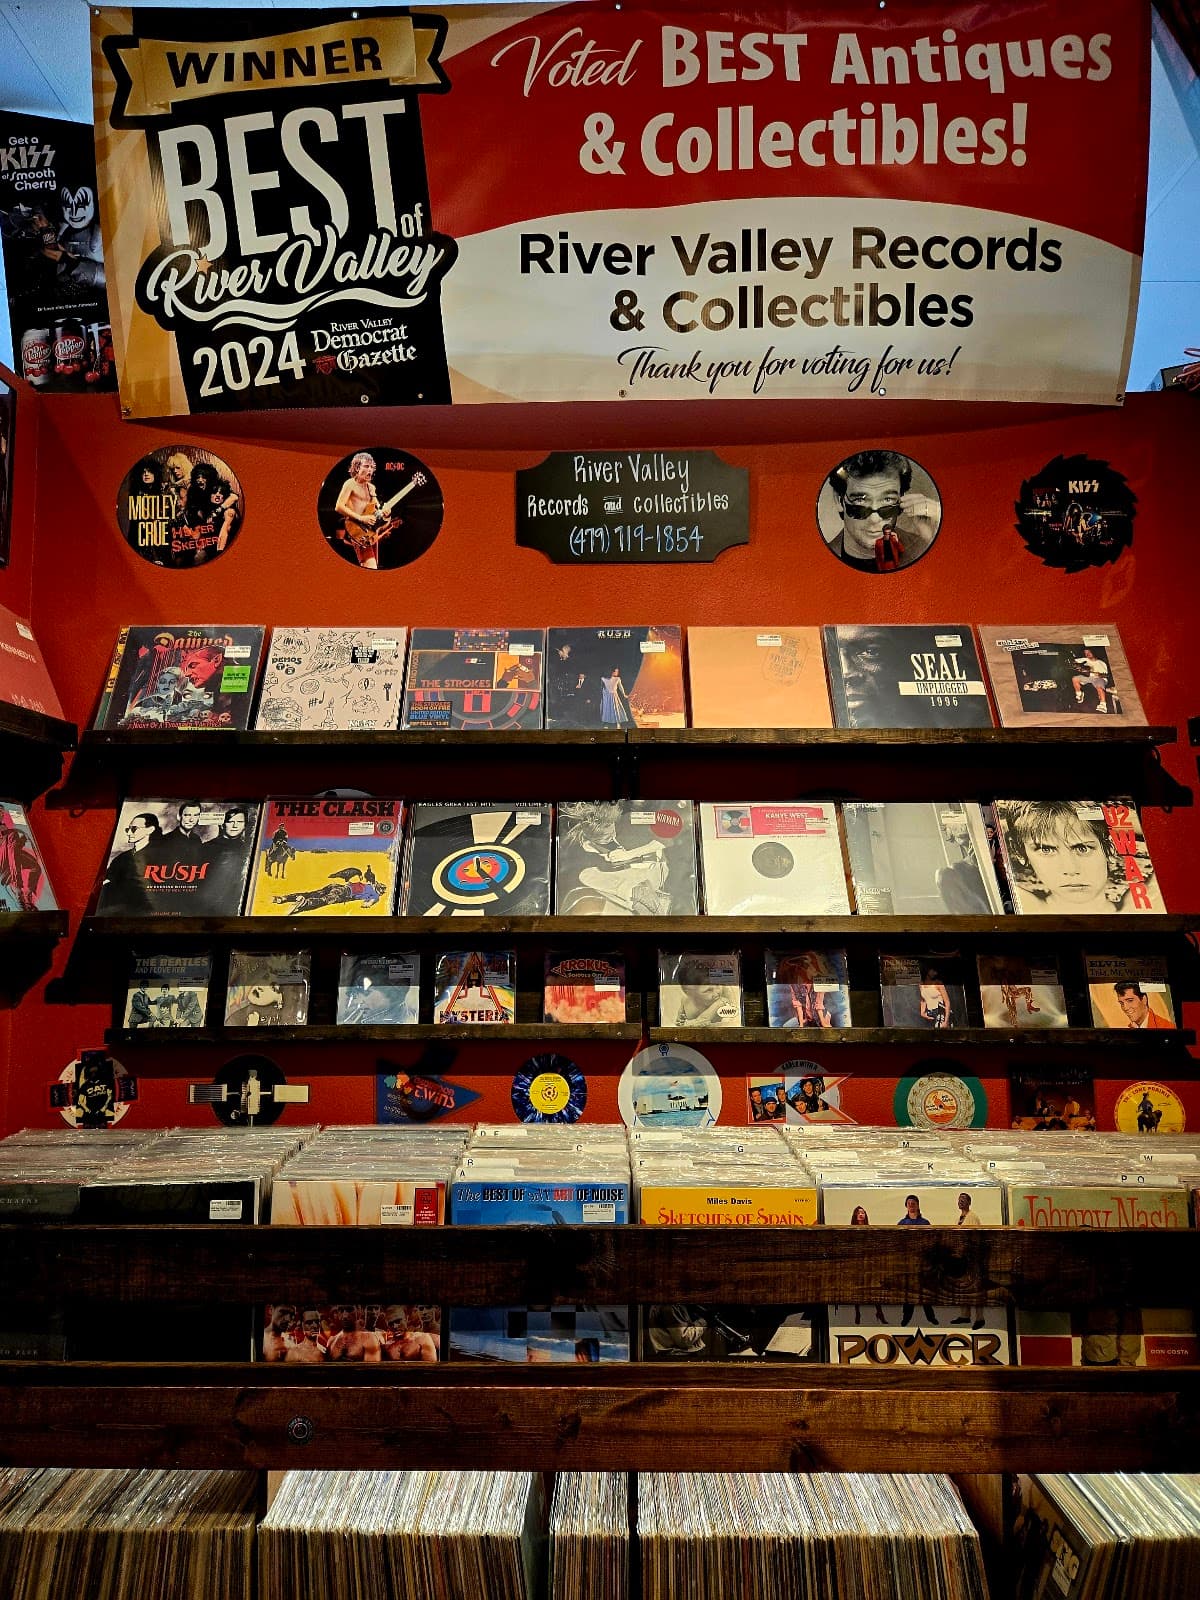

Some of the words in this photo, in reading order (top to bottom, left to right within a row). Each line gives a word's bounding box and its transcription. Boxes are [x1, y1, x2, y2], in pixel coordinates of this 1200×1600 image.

[167, 36, 383, 89] WINNER
[491, 27, 643, 98] Voted
[661, 25, 807, 88] BEST
[830, 28, 1112, 94] Antiques
[8, 136, 29, 147] Get
[30, 136, 39, 145] a
[579, 112, 626, 175] &
[640, 102, 1028, 177] Collectibles!
[0, 144, 56, 171] KISS
[14, 179, 57, 192] Cherry
[158, 98, 406, 262] BEST
[400, 202, 424, 240] of
[520, 230, 655, 276] River
[670, 228, 833, 280] Valley
[852, 226, 1062, 273] Records
[146, 248, 276, 318] River
[276, 225, 446, 298] Valley
[609, 289, 645, 332] &
[662, 282, 974, 333] Collectibles
[330, 320, 360, 332] RIVER
[361, 317, 393, 330] VALLEY
[310, 323, 409, 352] Democrat
[192, 331, 307, 398] 2024
[337, 343, 418, 374] Gazette
[617, 345, 708, 386] Thank
[706, 362, 752, 394] you
[746, 345, 797, 394] for
[802, 345, 872, 393] voting
[868, 345, 916, 394] for
[916, 345, 962, 377] us!
[574, 455, 623, 484] River
[628, 453, 690, 493] Valley
[1068, 479, 1100, 494] KISS
[528, 494, 589, 517] Records
[569, 524, 610, 556] (479)
[614, 524, 704, 553] 719-1854
[910, 653, 967, 681] SEAL
[420, 679, 441, 688] THE
[444, 679, 491, 688] STROKES
[917, 682, 969, 694] UNPLUGGED
[930, 696, 959, 707] 1996
[274, 801, 320, 817] THE
[323, 801, 395, 817] CLASH
[656, 812, 681, 827] NIRVANA
[1102, 804, 1133, 827] U2
[143, 861, 211, 883] RUSH
[1109, 829, 1153, 910] WAR
[135, 958, 156, 967] THE
[159, 957, 209, 967] BEATLES
[560, 959, 609, 974] KROKUS
[1089, 960, 1127, 968] ELVIS
[576, 1144, 583, 1152] C
[460, 1169, 465, 1177] A
[457, 1188, 481, 1201] The
[482, 1188, 511, 1201] BEST
[512, 1188, 526, 1201] OF
[552, 1188, 575, 1201] ART
[576, 1188, 591, 1201] OF
[592, 1188, 624, 1202] NOISE
[706, 1197, 728, 1205] Miles
[730, 1197, 752, 1205] Davis
[657, 1207, 732, 1224] SKETCHES
[735, 1212, 753, 1224] OF
[757, 1207, 804, 1224] SPAIN
[1023, 1195, 1112, 1227] Johnny
[1111, 1196, 1178, 1227] Nash
